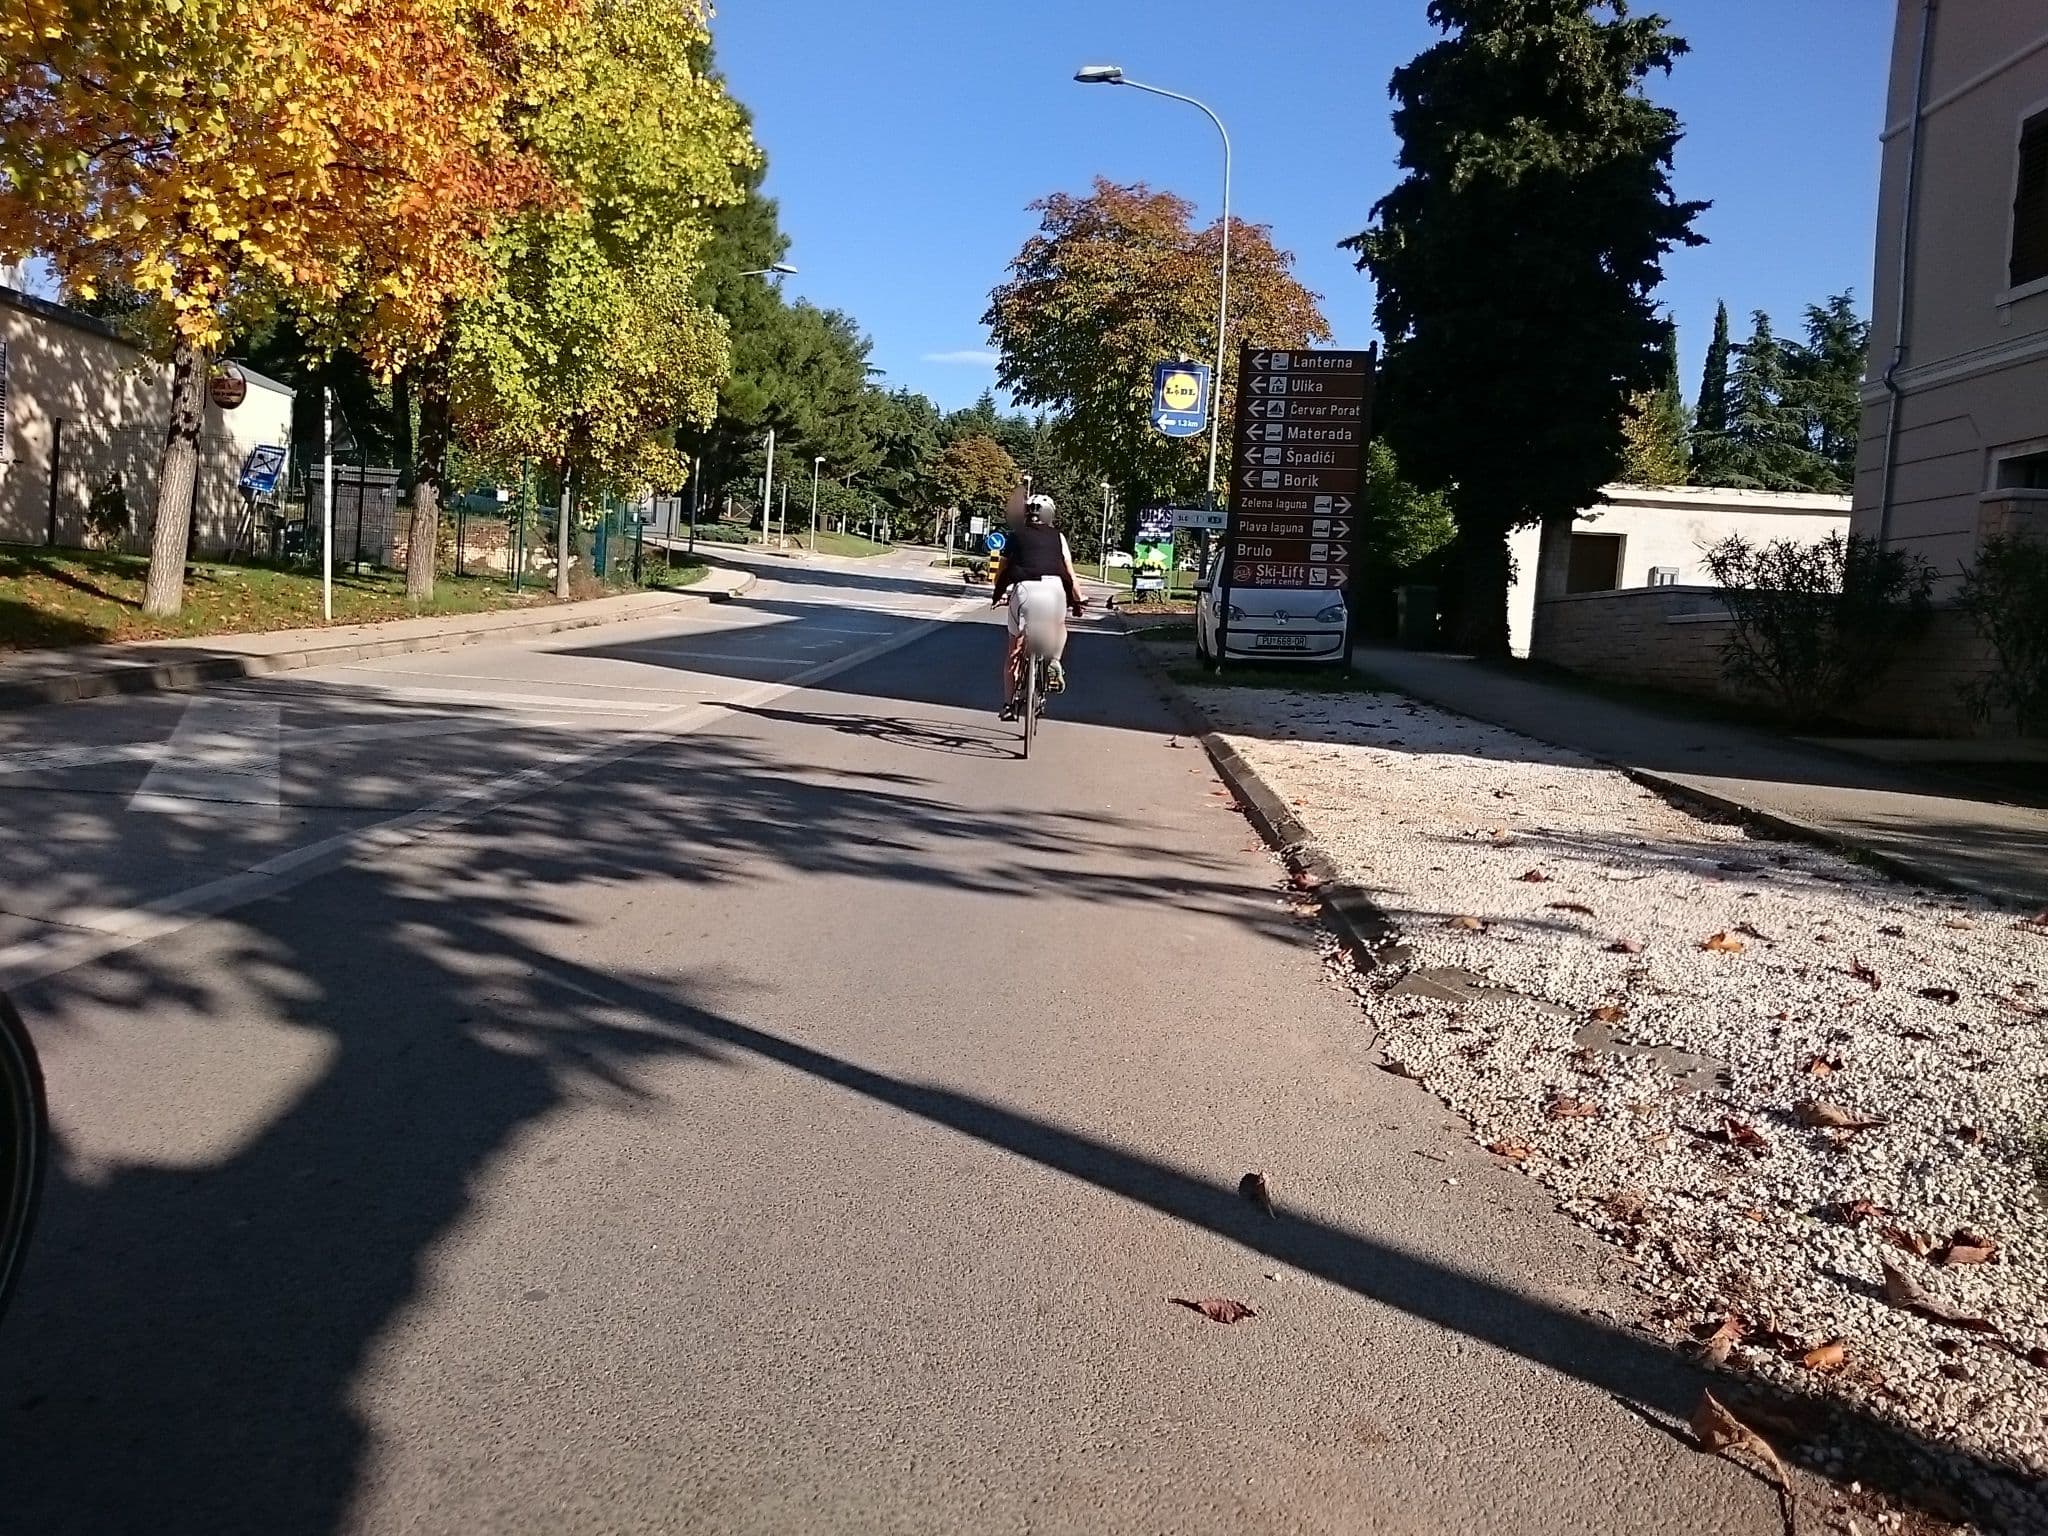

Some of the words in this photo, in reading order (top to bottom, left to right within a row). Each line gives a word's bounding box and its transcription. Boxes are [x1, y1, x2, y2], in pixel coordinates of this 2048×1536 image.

[1293, 355, 1353, 368] Lanterna
[1291, 379, 1323, 392] Ulika
[1290, 401, 1327, 415] Červar
[1330, 404, 1360, 416] Porat
[1187, 420, 1199, 428] km
[1287, 426, 1352, 440] Materada
[1286, 447, 1335, 466] Špadići
[1284, 473, 1319, 487] Borik
[1241, 497, 1273, 509] Zelena
[1275, 498, 1307, 512] laguna
[1239, 520, 1268, 532] Plava
[1270, 521, 1304, 536] laguna
[1237, 543, 1273, 557] Brulo
[1256, 564, 1305, 579] Ski-Lift
[1255, 577, 1276, 586] Sport
[1278, 578, 1303, 586] center
